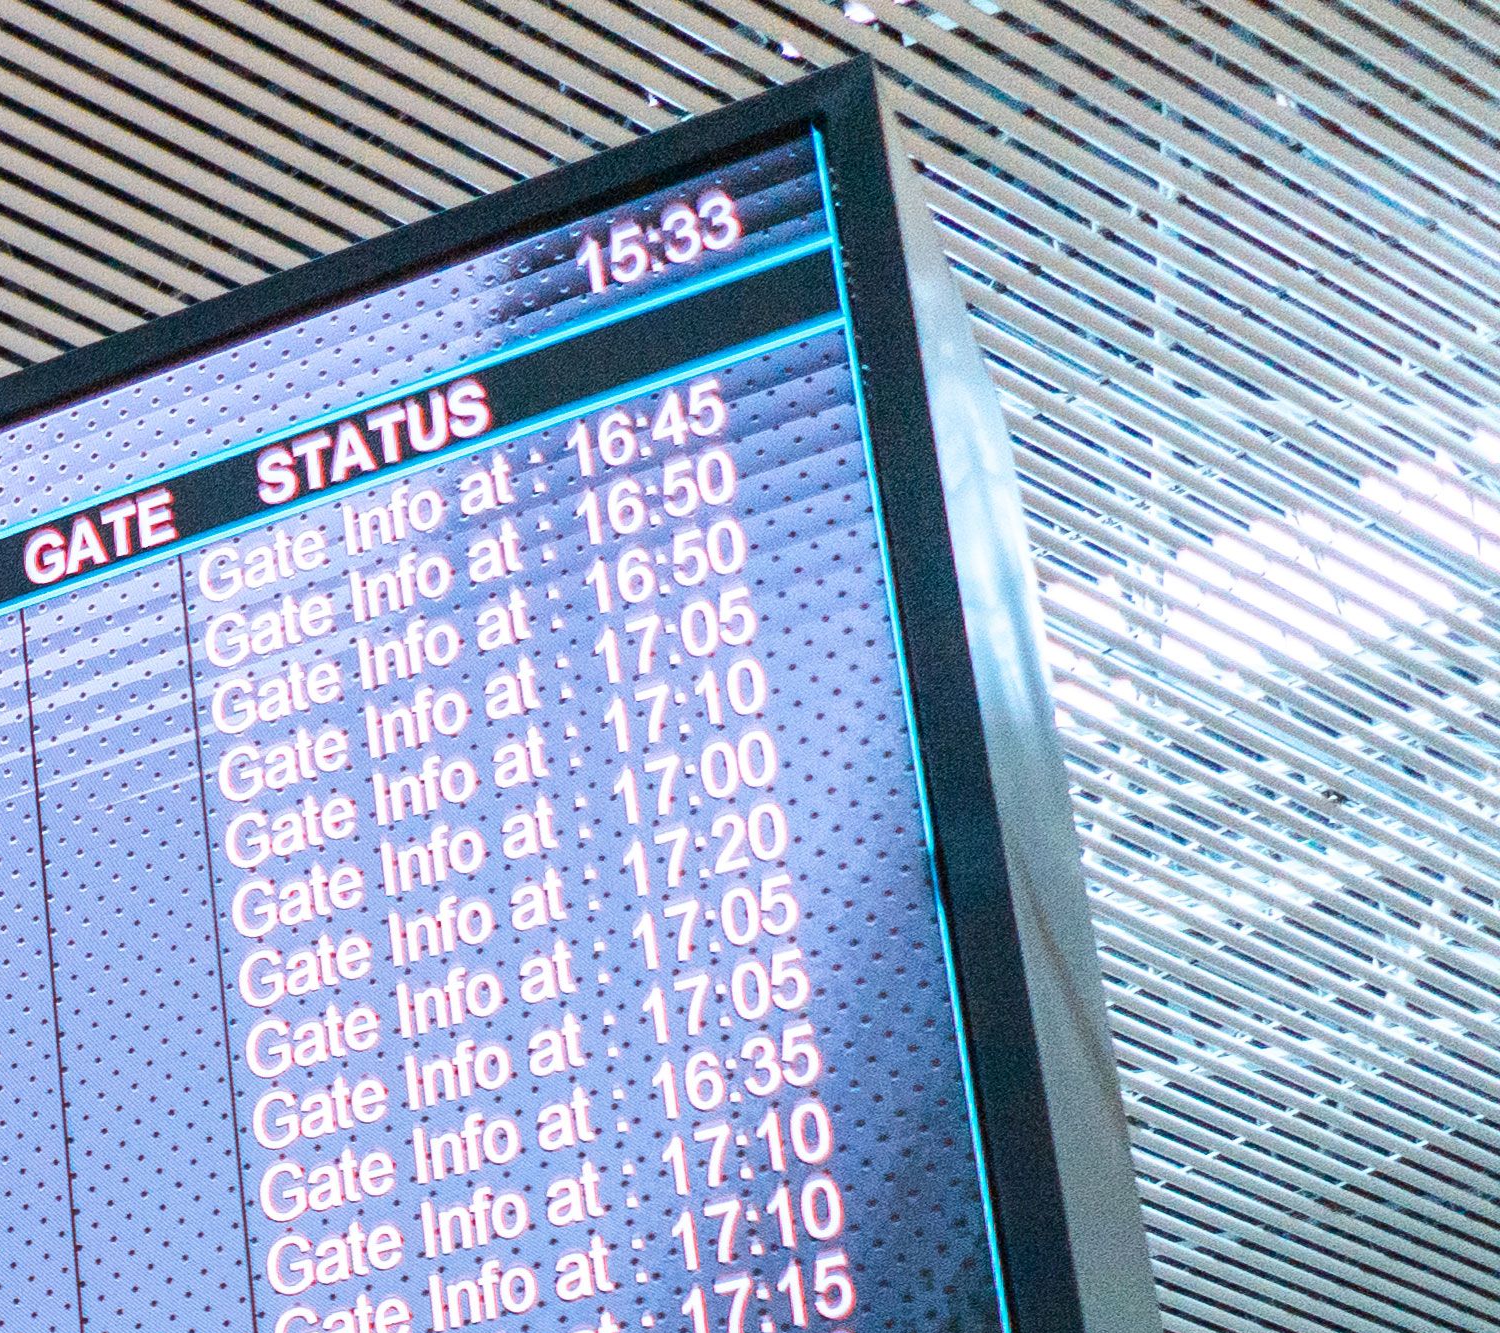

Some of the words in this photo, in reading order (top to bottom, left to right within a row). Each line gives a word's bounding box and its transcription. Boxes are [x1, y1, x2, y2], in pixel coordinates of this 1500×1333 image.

[576, 192, 742, 294] 15:33
[23, 490, 179, 585] GATE
[257, 379, 491, 505] STATUS
[194, 591, 338, 669] Gate
[340, 549, 455, 624] Info
[465, 515, 525, 584] at
[575, 443, 740, 546] 16:50
[426, 1256, 541, 1333] Info
[553, 1233, 616, 1301] at
[669, 1174, 845, 1271] 17:10
